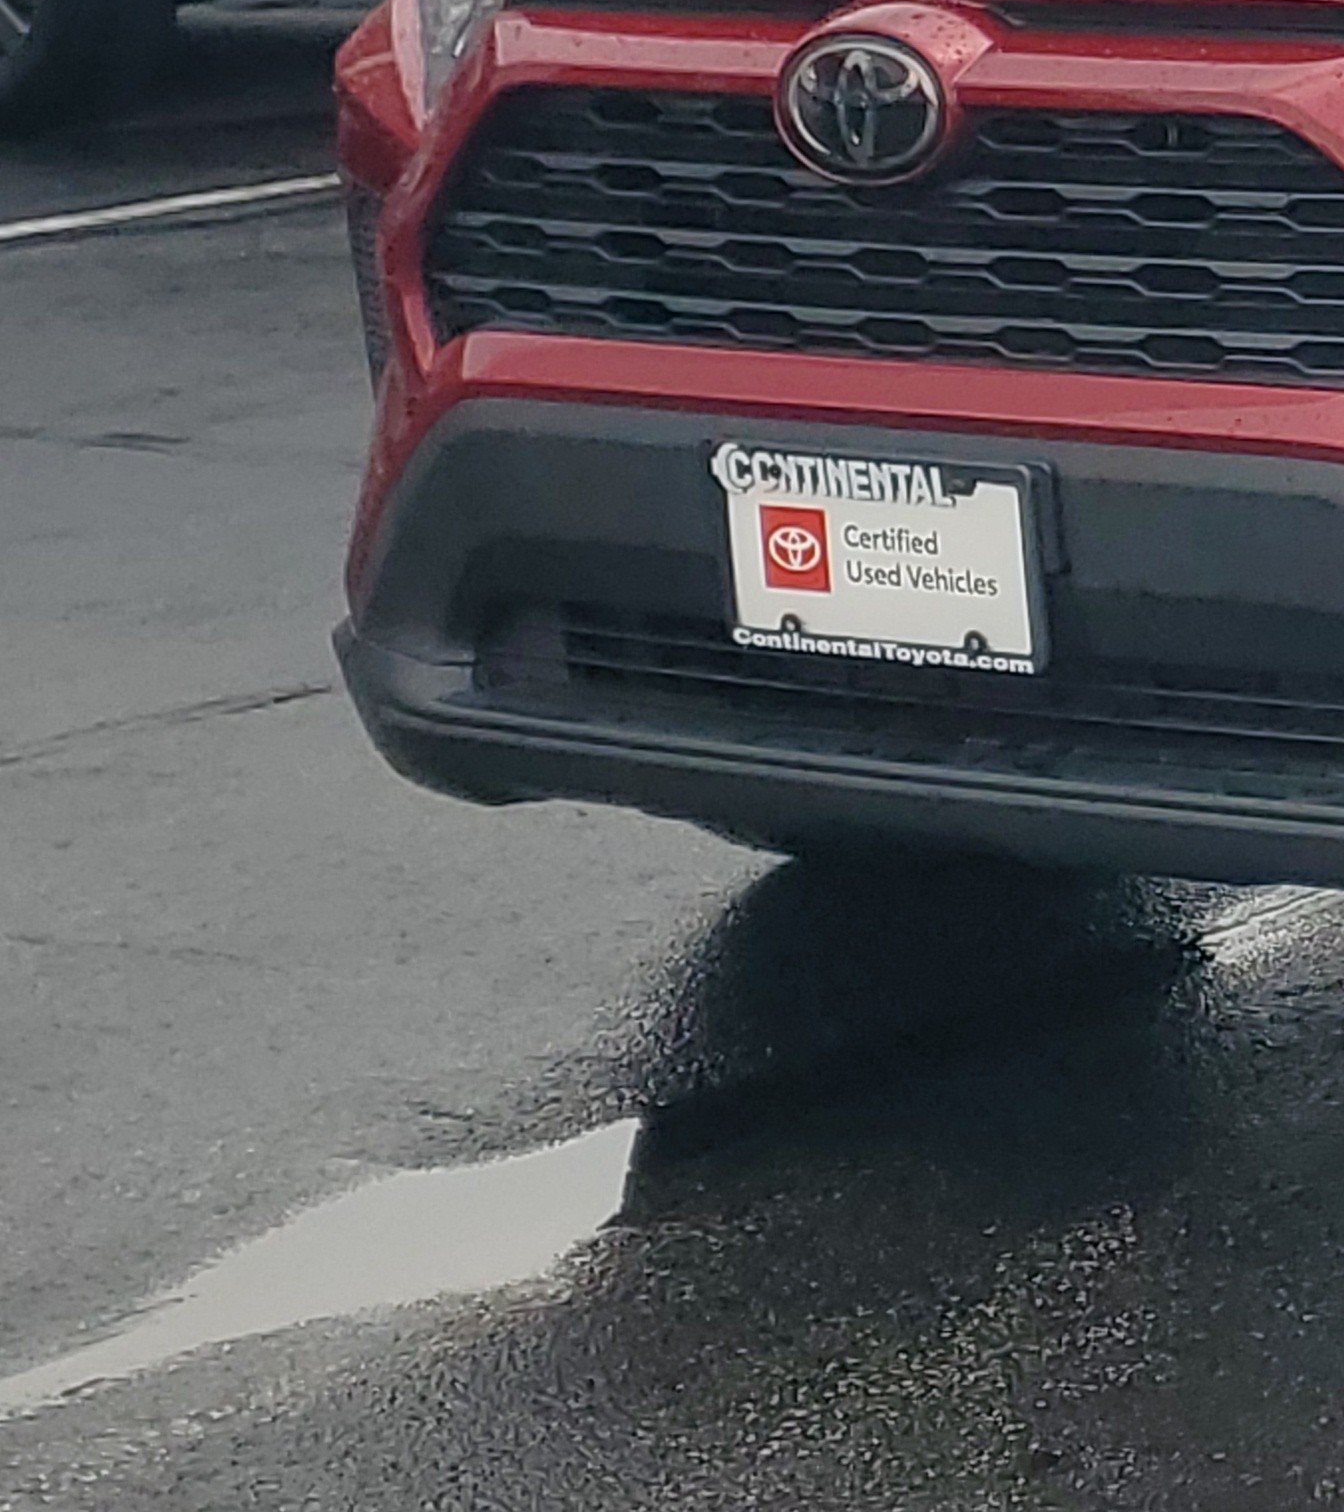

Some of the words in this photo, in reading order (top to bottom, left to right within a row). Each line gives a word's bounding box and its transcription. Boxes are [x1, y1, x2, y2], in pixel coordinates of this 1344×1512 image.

[844, 524, 939, 556] Certified
[846, 560, 901, 587] Used
[906, 565, 998, 597] Vehicles
[733, 627, 1034, 675] ContinentalToyota.com
